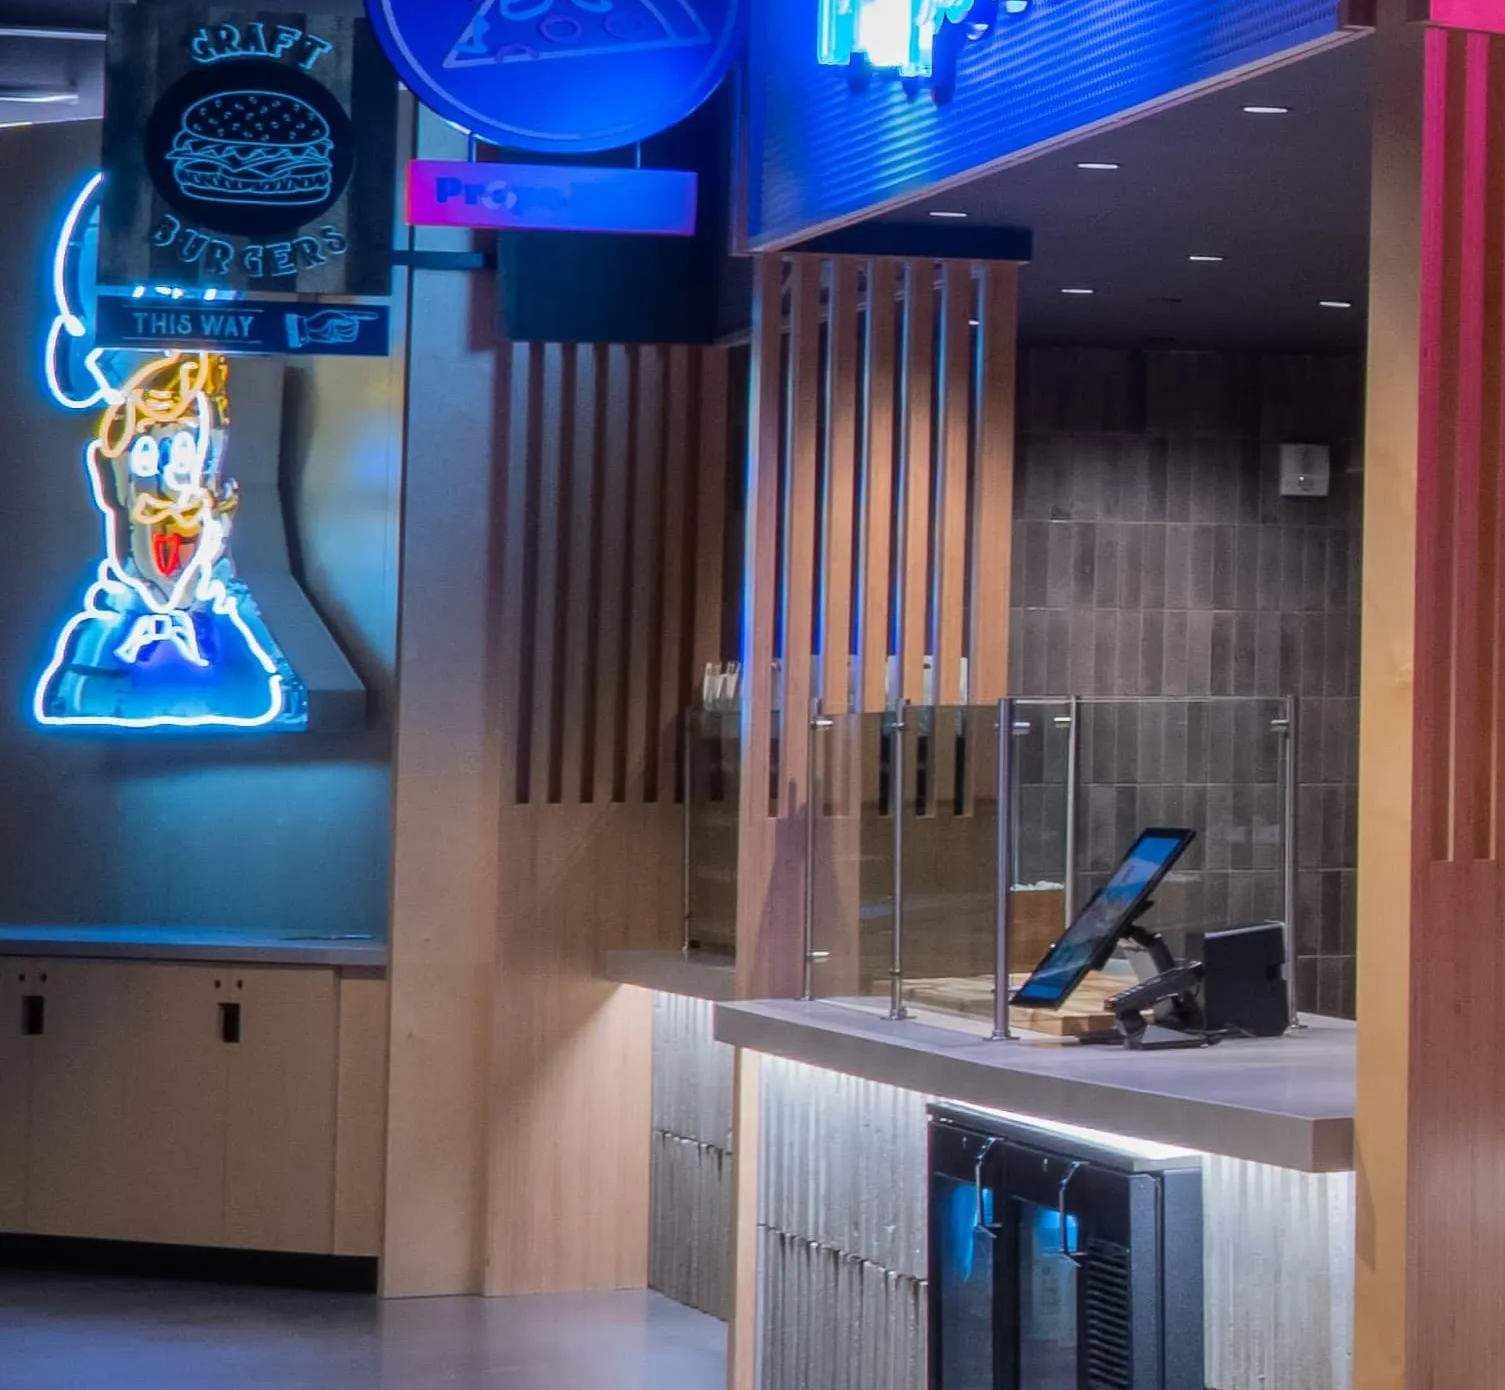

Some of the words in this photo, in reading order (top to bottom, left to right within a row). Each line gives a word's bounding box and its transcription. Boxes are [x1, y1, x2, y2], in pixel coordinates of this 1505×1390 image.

[190, 21, 333, 70] CRAFT
[151, 213, 348, 278] BURGERS
[133, 311, 192, 336] THIS
[200, 313, 254, 338] WAY
